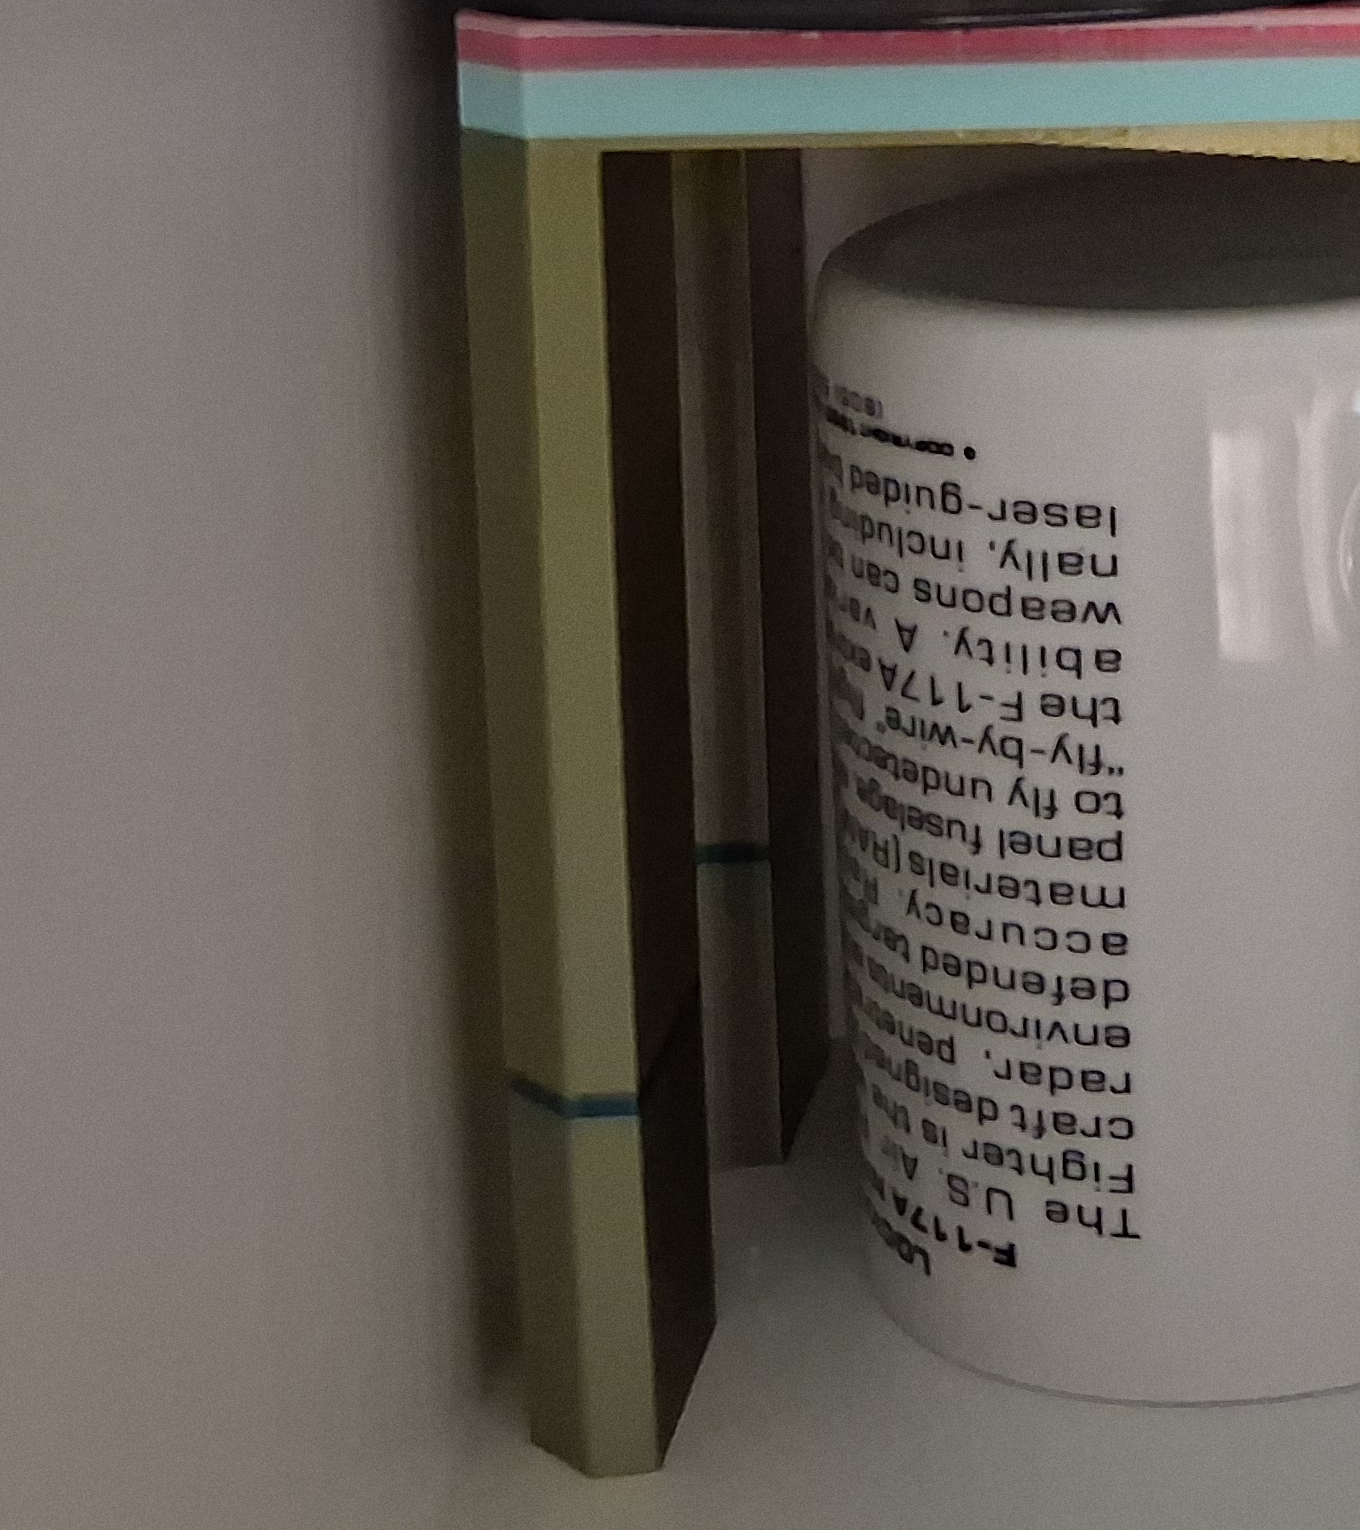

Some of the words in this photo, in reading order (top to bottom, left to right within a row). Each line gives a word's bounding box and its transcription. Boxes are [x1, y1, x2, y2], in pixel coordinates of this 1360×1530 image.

[850, 464, 1117, 538] laser-guided
[852, 556, 899, 593] can
[988, 538, 1118, 583] nally,
[913, 576, 1122, 625] weapons
[894, 617, 918, 654] A
[943, 626, 1122, 680] ability.
[878, 657, 1024, 723] F-117A
[1040, 692, 1121, 727] the
[1007, 775, 1058, 820] fly
[1074, 790, 1123, 820] to
[999, 826, 1124, 862] panel
[908, 850, 1126, 908] materials
[921, 944, 1130, 1009] defended
[984, 1048, 1132, 1096] radar,
[921, 1118, 948, 1157] is
[1010, 1104, 1135, 1140] craft
[961, 1139, 1135, 1194] Fighter
[937, 1167, 1014, 1221] U.S.
[892, 1188, 1017, 1267] F-117A
[1045, 1198, 1141, 1240] The
